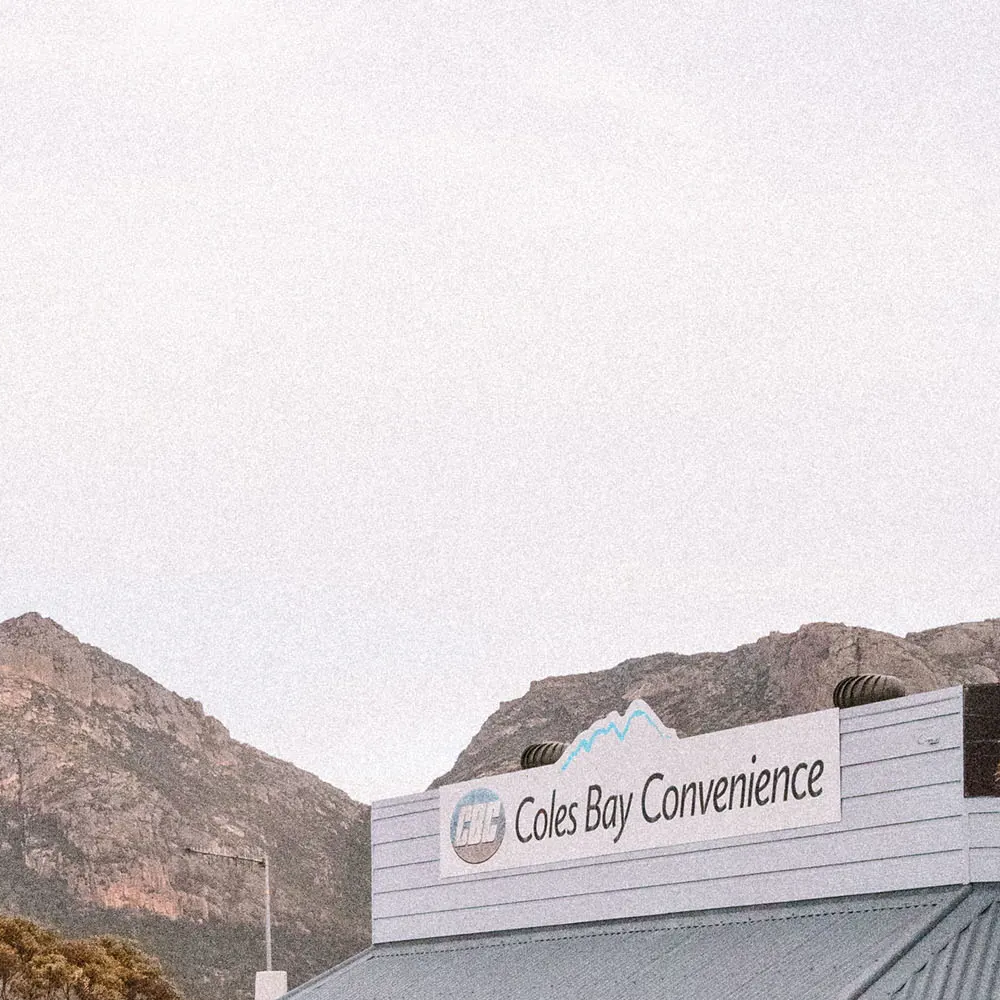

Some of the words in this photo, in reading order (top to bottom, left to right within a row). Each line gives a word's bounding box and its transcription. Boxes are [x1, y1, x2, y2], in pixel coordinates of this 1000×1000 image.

[515, 789, 578, 843] Coles
[585, 784, 633, 844] Bay
[640, 754, 825, 824] Convenience
